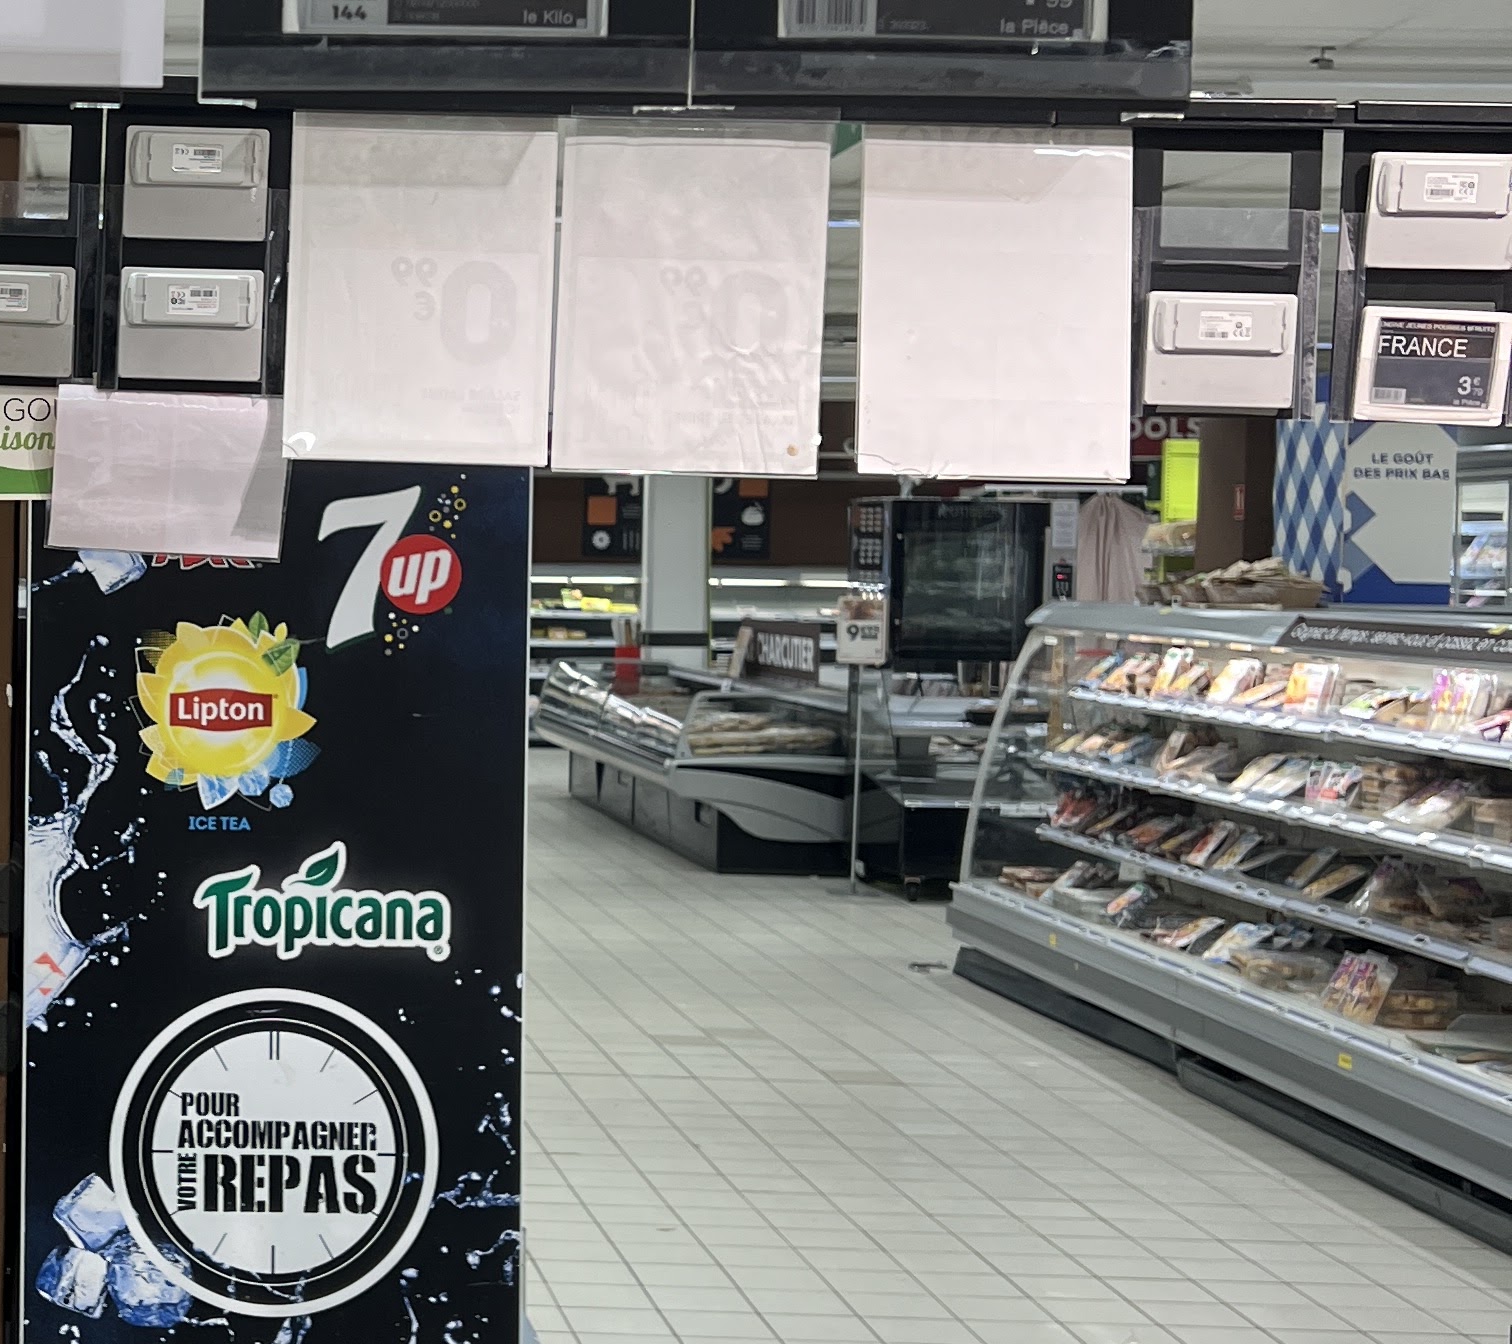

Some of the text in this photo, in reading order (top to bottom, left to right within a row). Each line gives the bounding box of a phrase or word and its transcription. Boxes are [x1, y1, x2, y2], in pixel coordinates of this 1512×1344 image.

[331, 4, 574, 26] 144 le Kilo
[1000, 18, 1017, 35] la
[1377, 335, 1469, 358] FRANCE
[1457, 375, 1472, 396] 3
[2, 396, 58, 425] GO
[1130, 416, 1200, 440] OOLS
[1371, 452, 1389, 465] LE
[1353, 468, 1451, 482] DES PRIX BAS
[177, 695, 266, 726] Lipton
[188, 814, 252, 832] ICE TEA
[198, 868, 448, 956] Tropicana
[180, 1091, 241, 1118] POUR
[177, 1119, 378, 1152] ACCOMPAGNER
[177, 1152, 377, 1215] VOTRE REPAS
